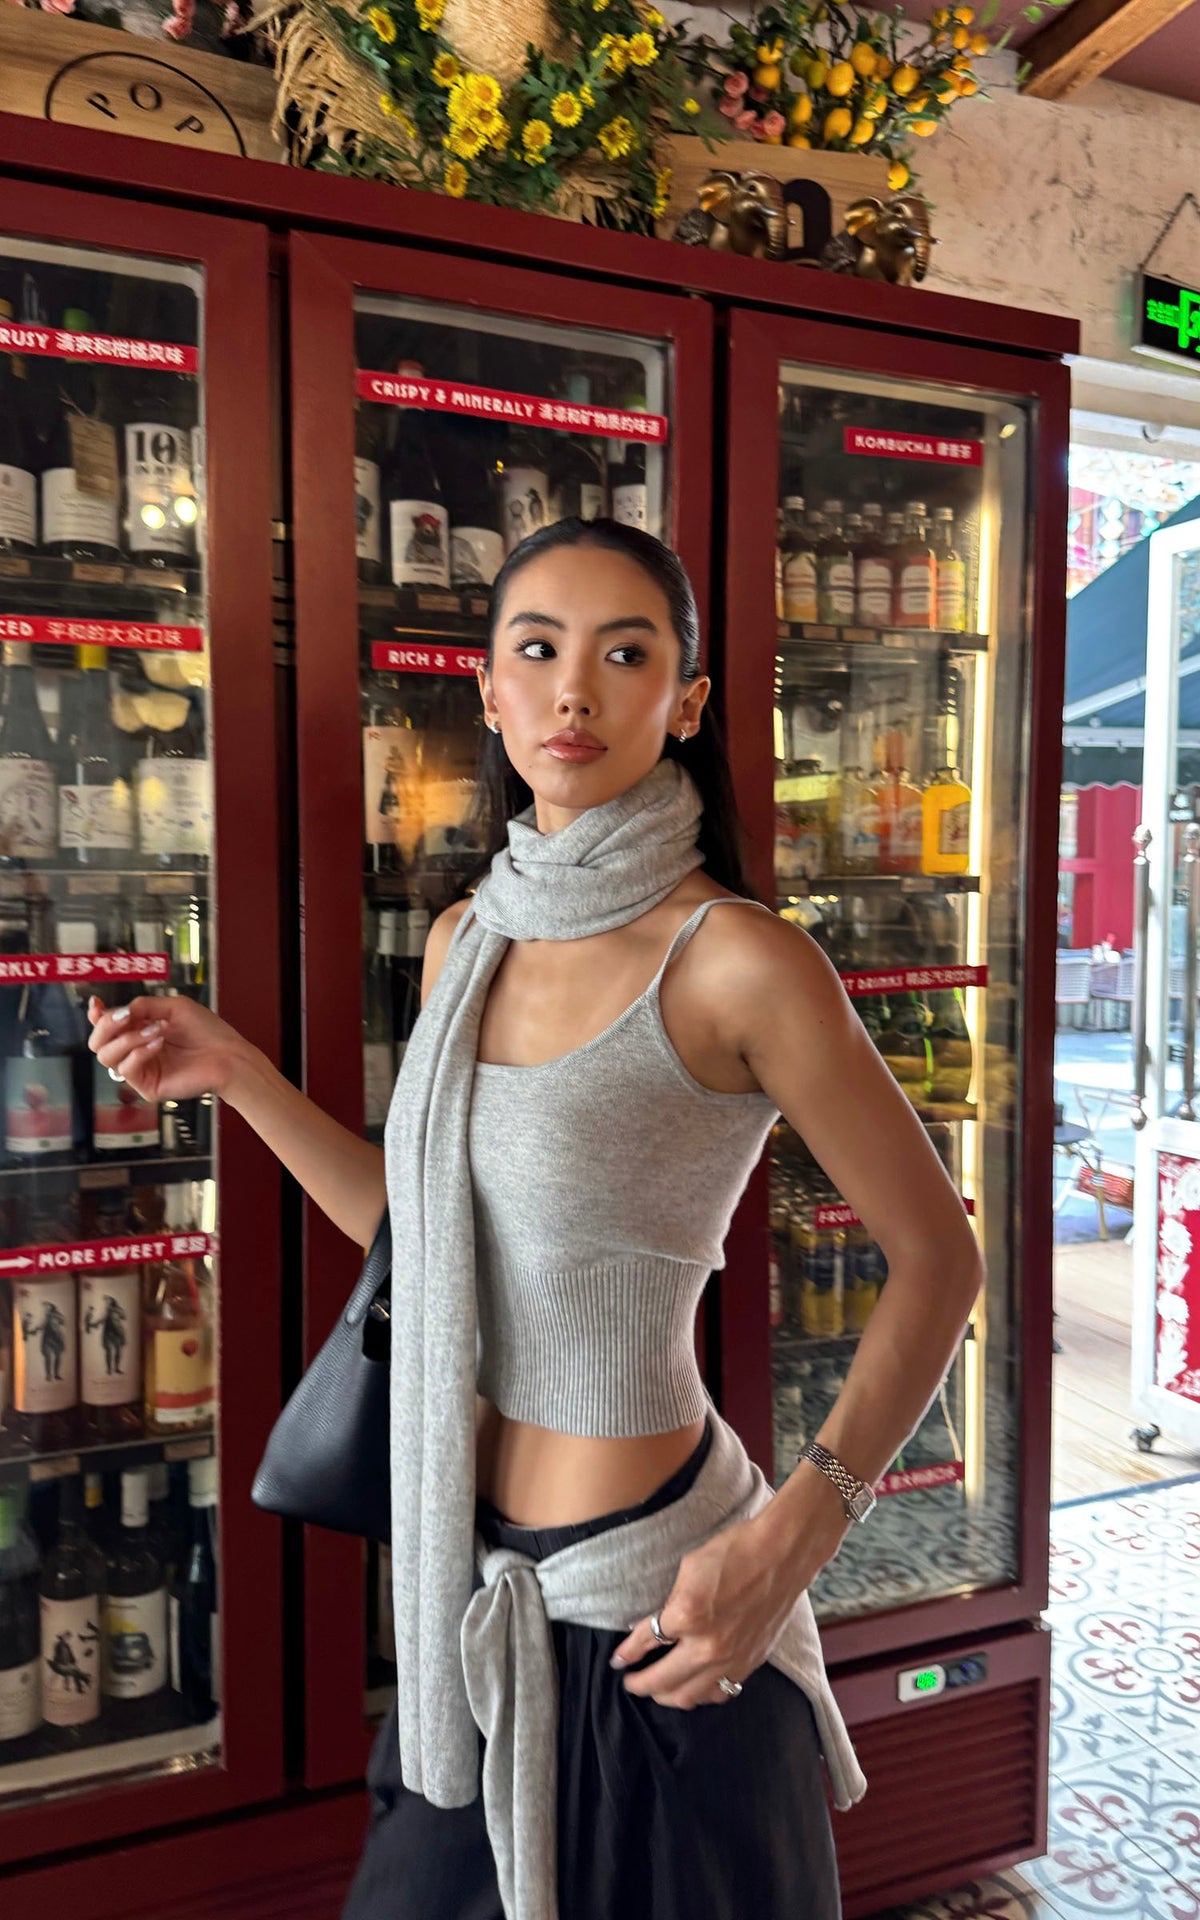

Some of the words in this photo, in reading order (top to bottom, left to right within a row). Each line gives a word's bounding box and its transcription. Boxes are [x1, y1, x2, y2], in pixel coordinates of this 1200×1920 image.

[371, 379, 429, 401] CRISPY
[435, 388, 447, 404] &
[452, 391, 534, 418] MINERALY
[855, 435, 933, 455] KOMBUCHA
[387, 650, 430, 667] RICH
[434, 653, 446, 668] &
[38, 1247, 95, 1269] MORE
[101, 1241, 166, 1263] SWEET
